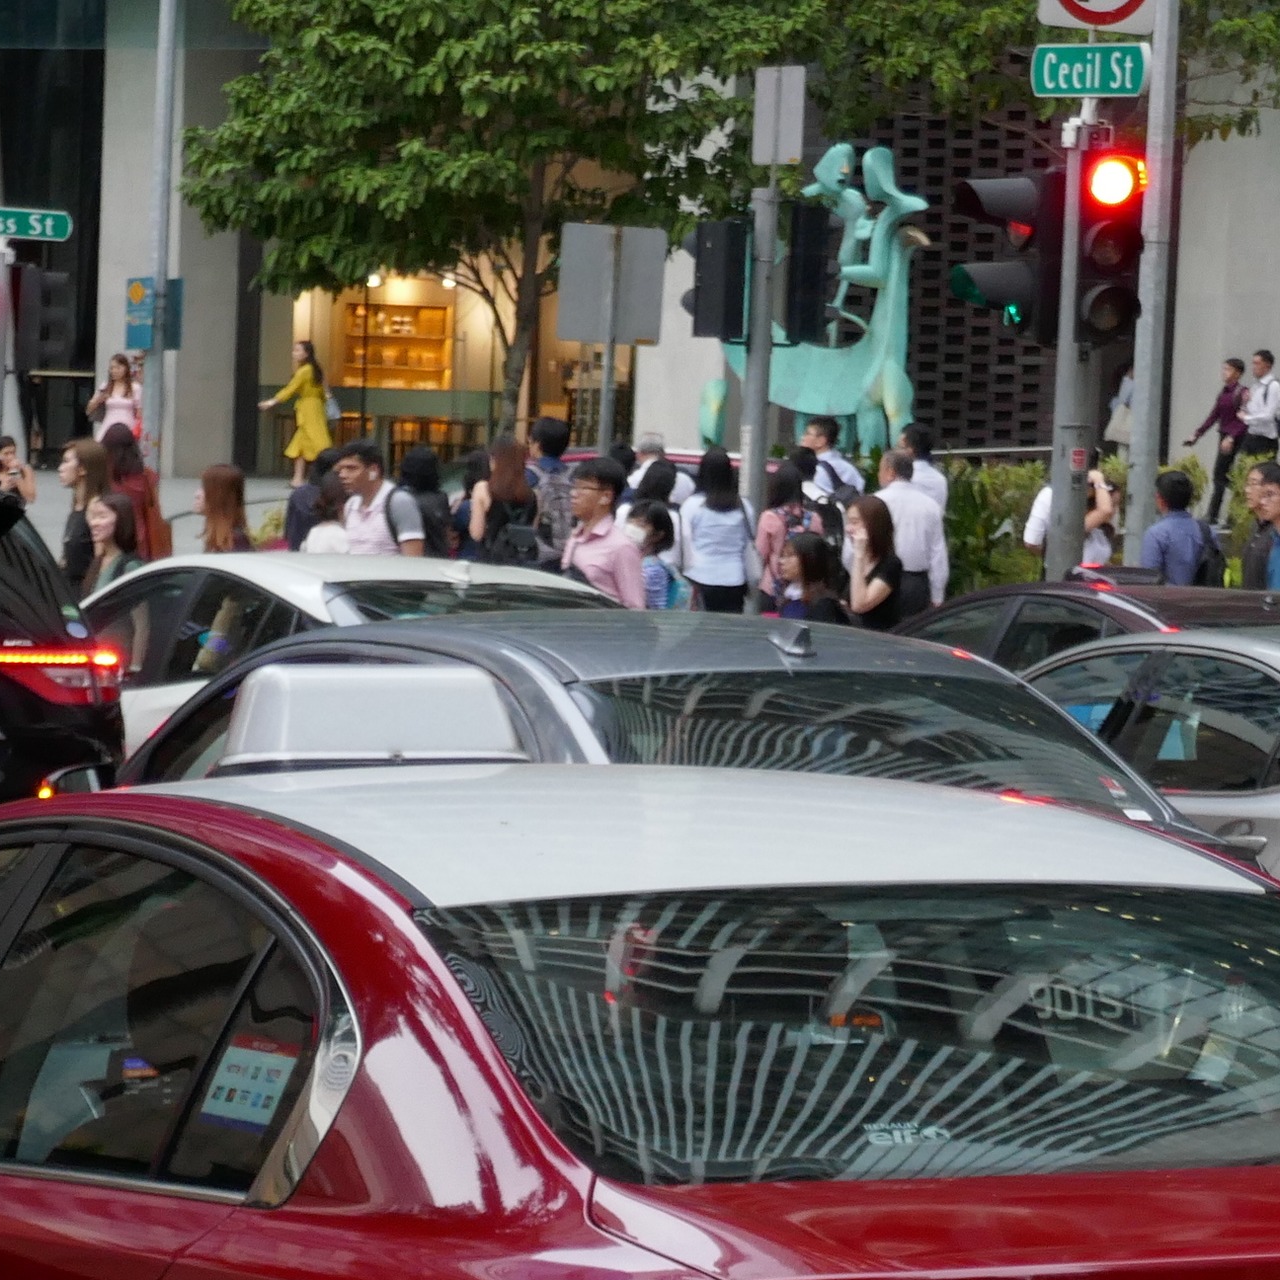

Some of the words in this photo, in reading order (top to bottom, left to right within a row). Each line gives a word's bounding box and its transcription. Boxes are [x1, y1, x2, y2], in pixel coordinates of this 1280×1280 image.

[1043, 52, 1101, 90] Cecil
[1109, 51, 1134, 90] St
[28, 214, 56, 236] St
